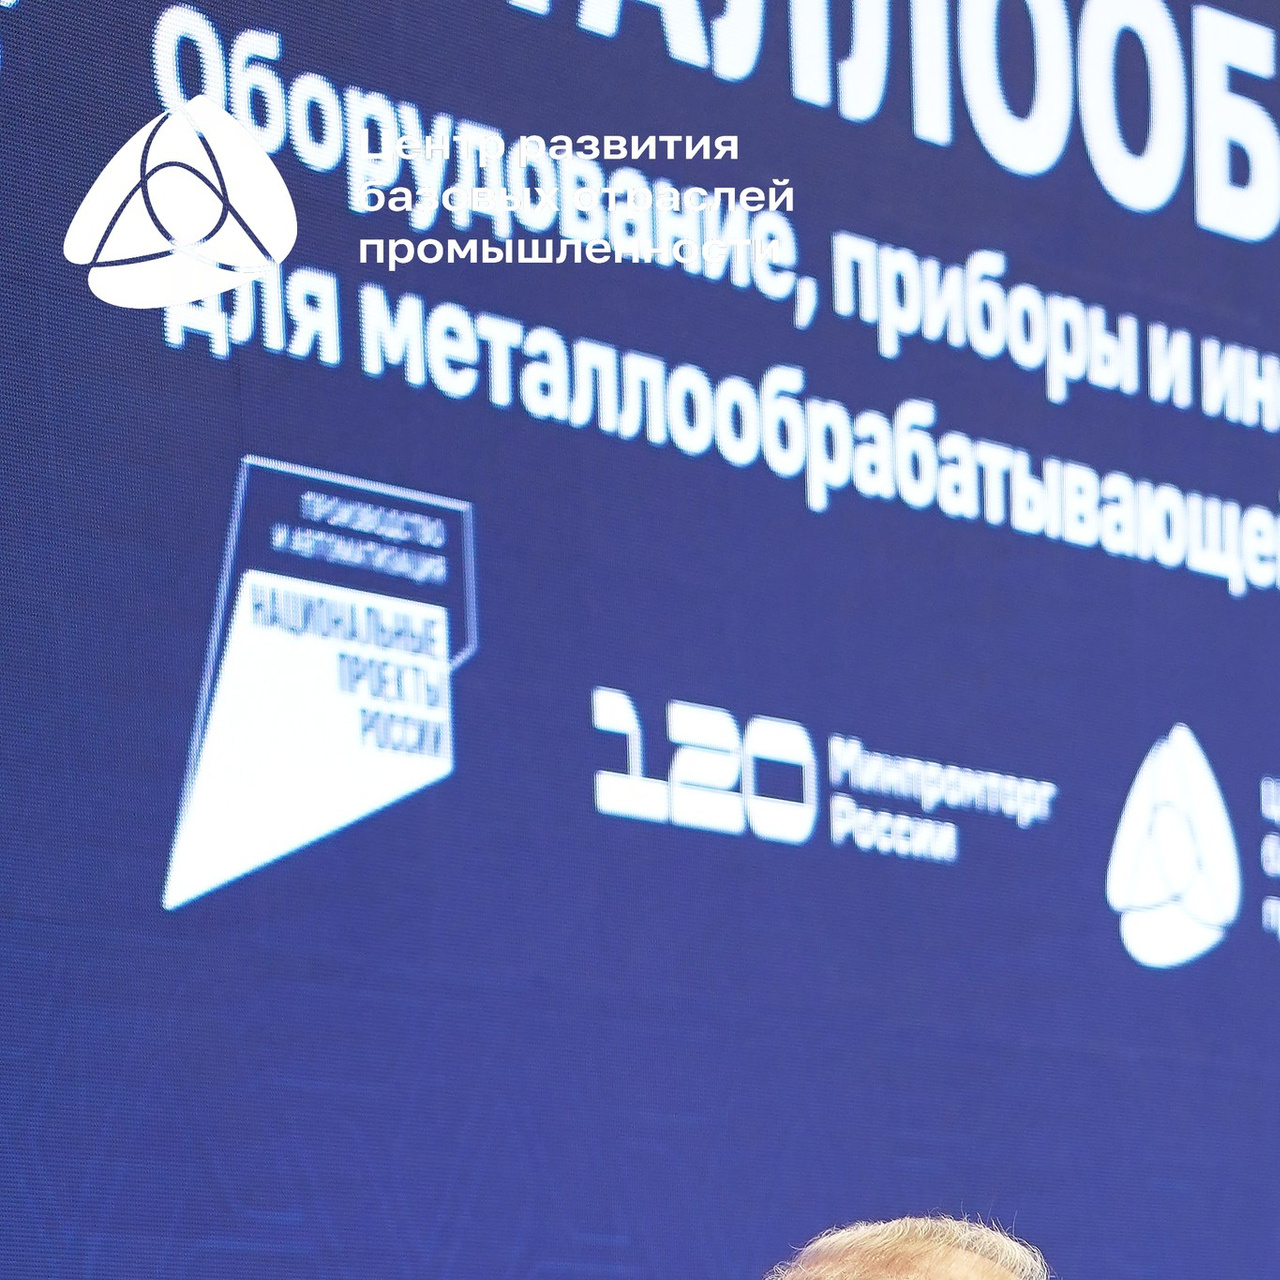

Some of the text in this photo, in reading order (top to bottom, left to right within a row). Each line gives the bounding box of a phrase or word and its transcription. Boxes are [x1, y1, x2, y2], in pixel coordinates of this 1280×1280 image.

[832, 231, 1139, 403] приборы
[1148, 321, 1192, 409] и
[592, 685, 819, 847] 120
[829, 791, 960, 865] России
